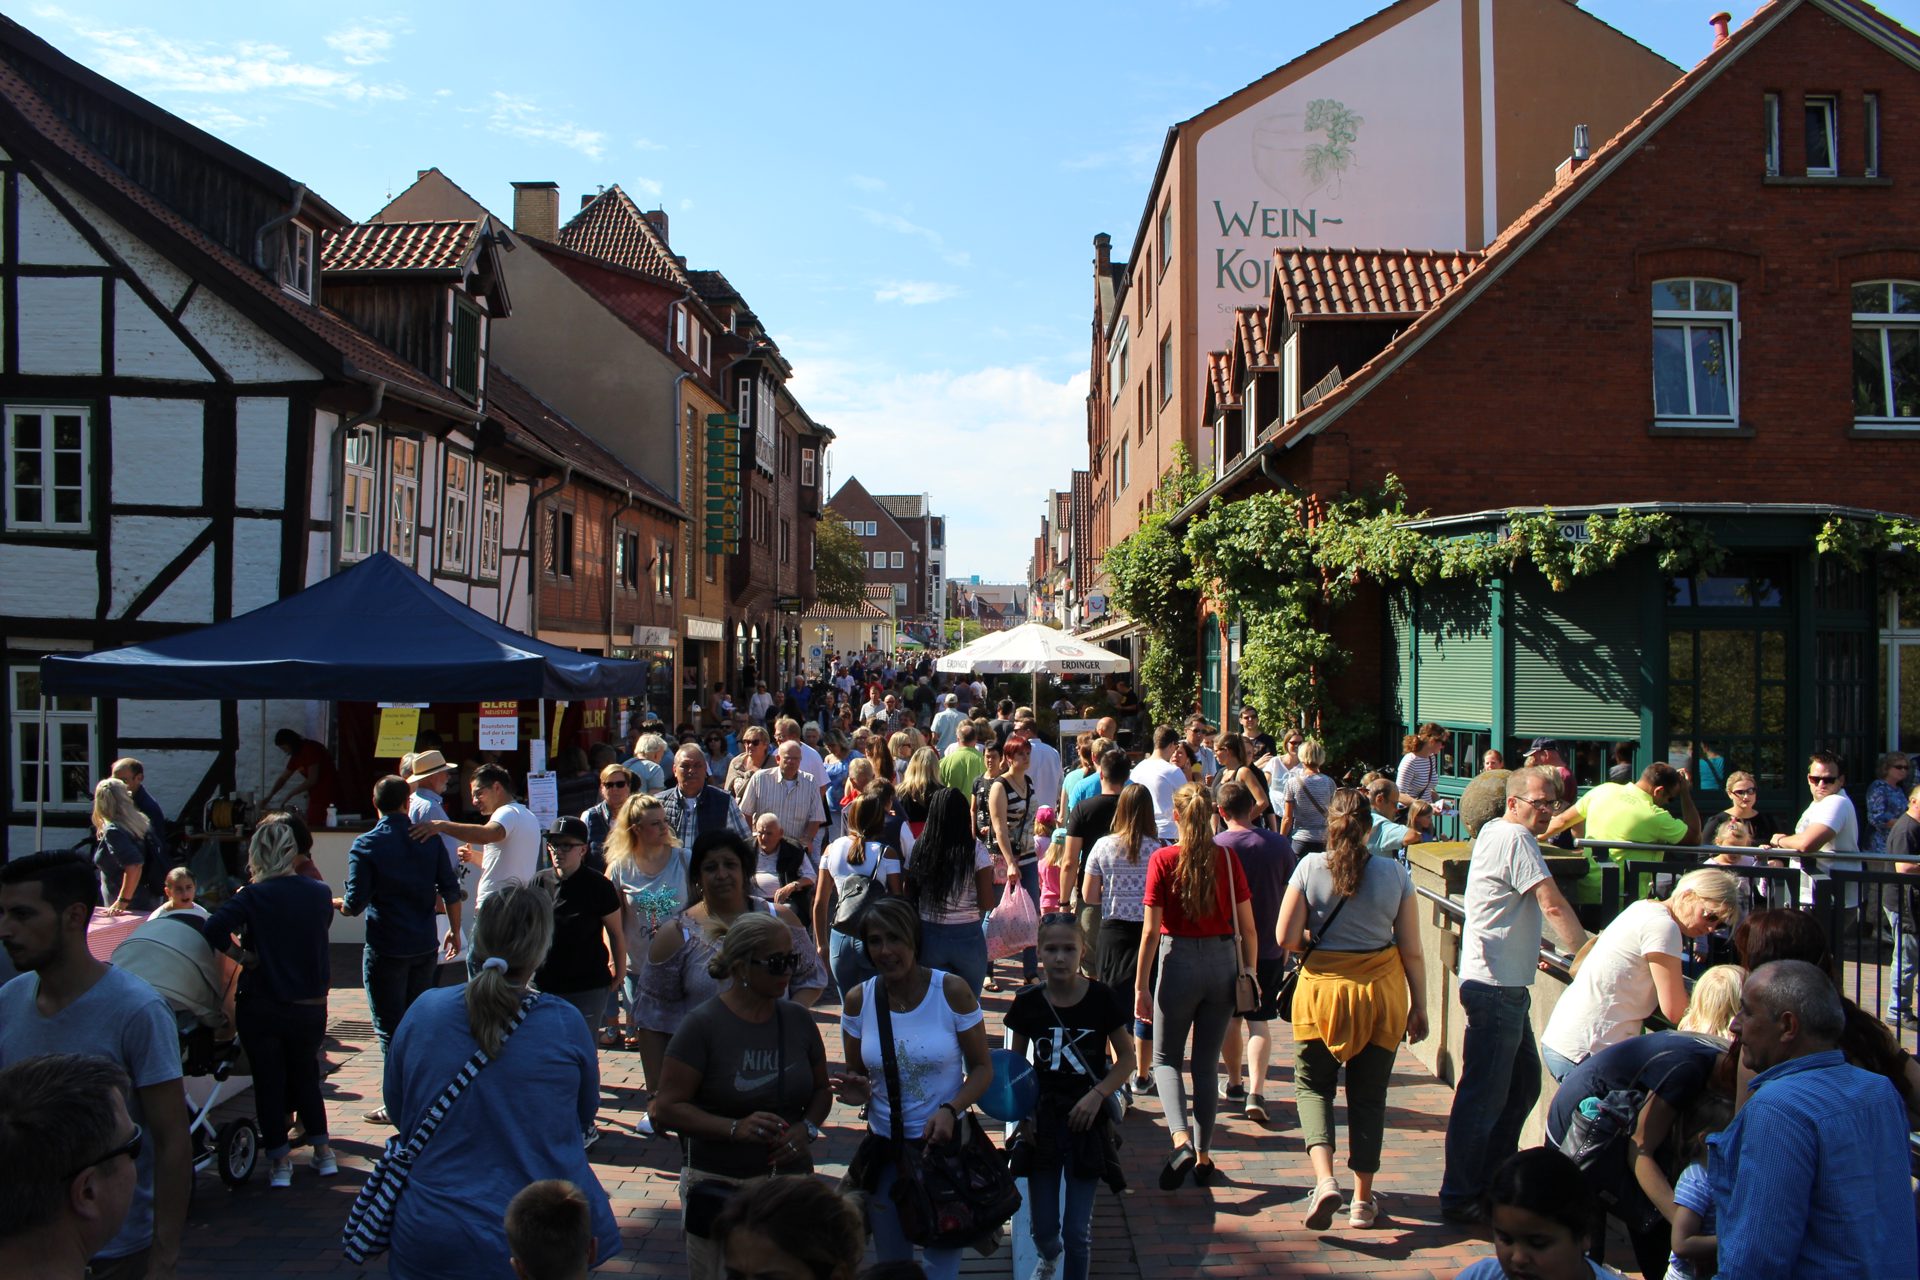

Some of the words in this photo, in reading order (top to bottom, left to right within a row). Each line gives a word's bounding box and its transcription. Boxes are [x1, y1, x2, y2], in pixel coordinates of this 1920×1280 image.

[721, 416, 737, 554] LEDERWAREN
[1061, 659, 1101, 670] ERDINGER
[481, 701, 518, 709] DLRG
